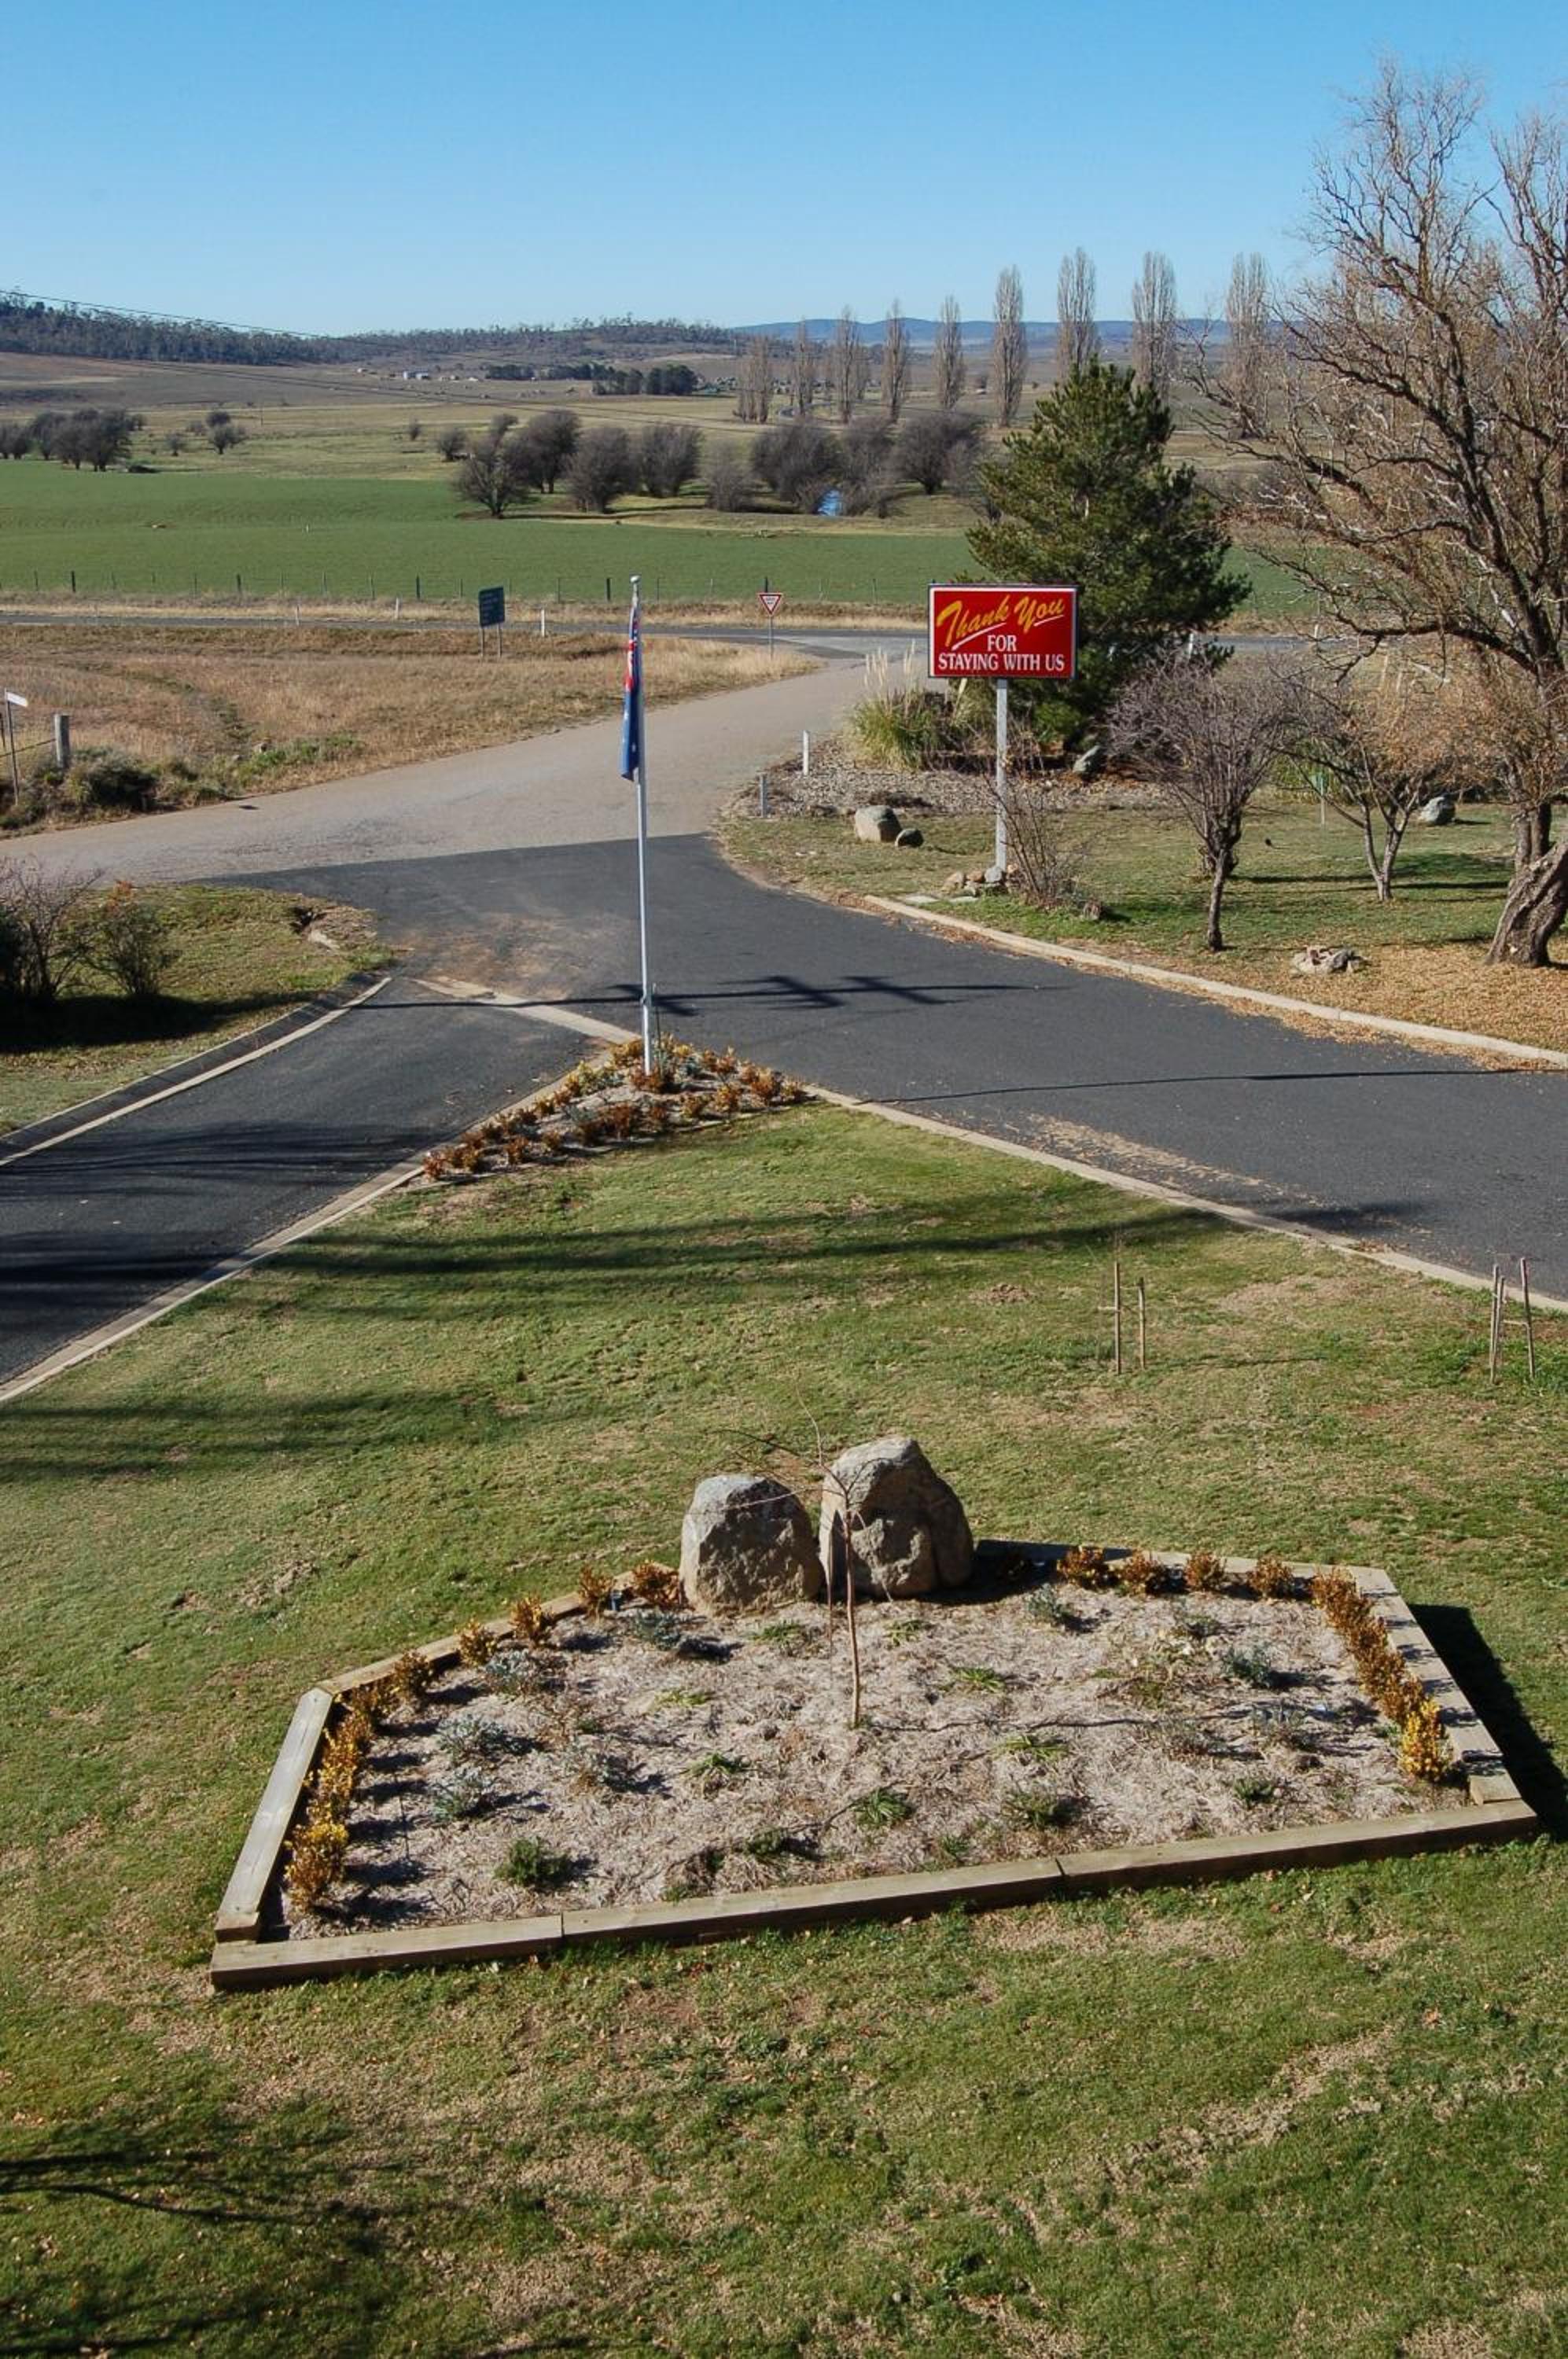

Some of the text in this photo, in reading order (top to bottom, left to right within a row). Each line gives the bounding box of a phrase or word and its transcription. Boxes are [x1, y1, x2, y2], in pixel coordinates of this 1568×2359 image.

[937, 594, 1065, 647] Thank You
[987, 635, 1017, 652] FOR
[938, 653, 1065, 671] STAYING WITH US
